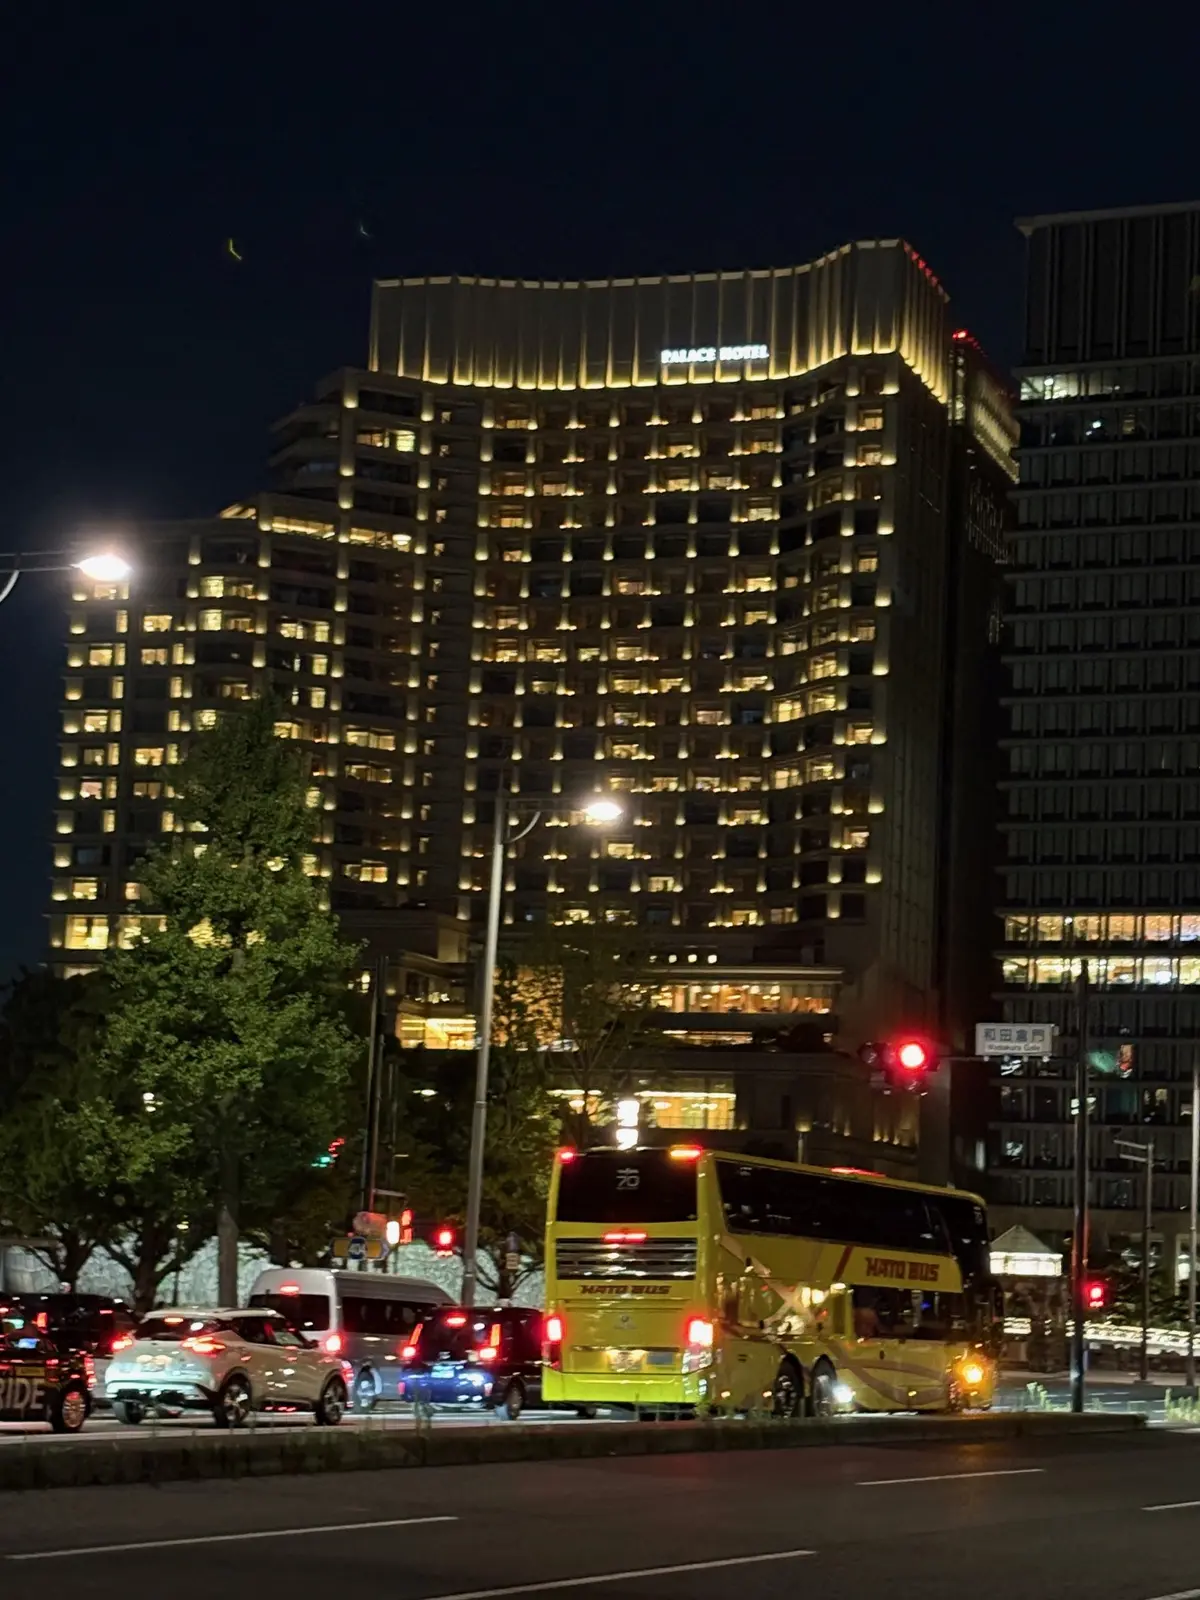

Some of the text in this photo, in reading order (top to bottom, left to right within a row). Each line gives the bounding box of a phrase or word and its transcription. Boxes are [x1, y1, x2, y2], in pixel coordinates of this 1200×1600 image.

[661, 344, 769, 363] PALACE HOTEL
[865, 1257, 940, 1282] HATO BUS
[630, 1285, 672, 1294] BUS
